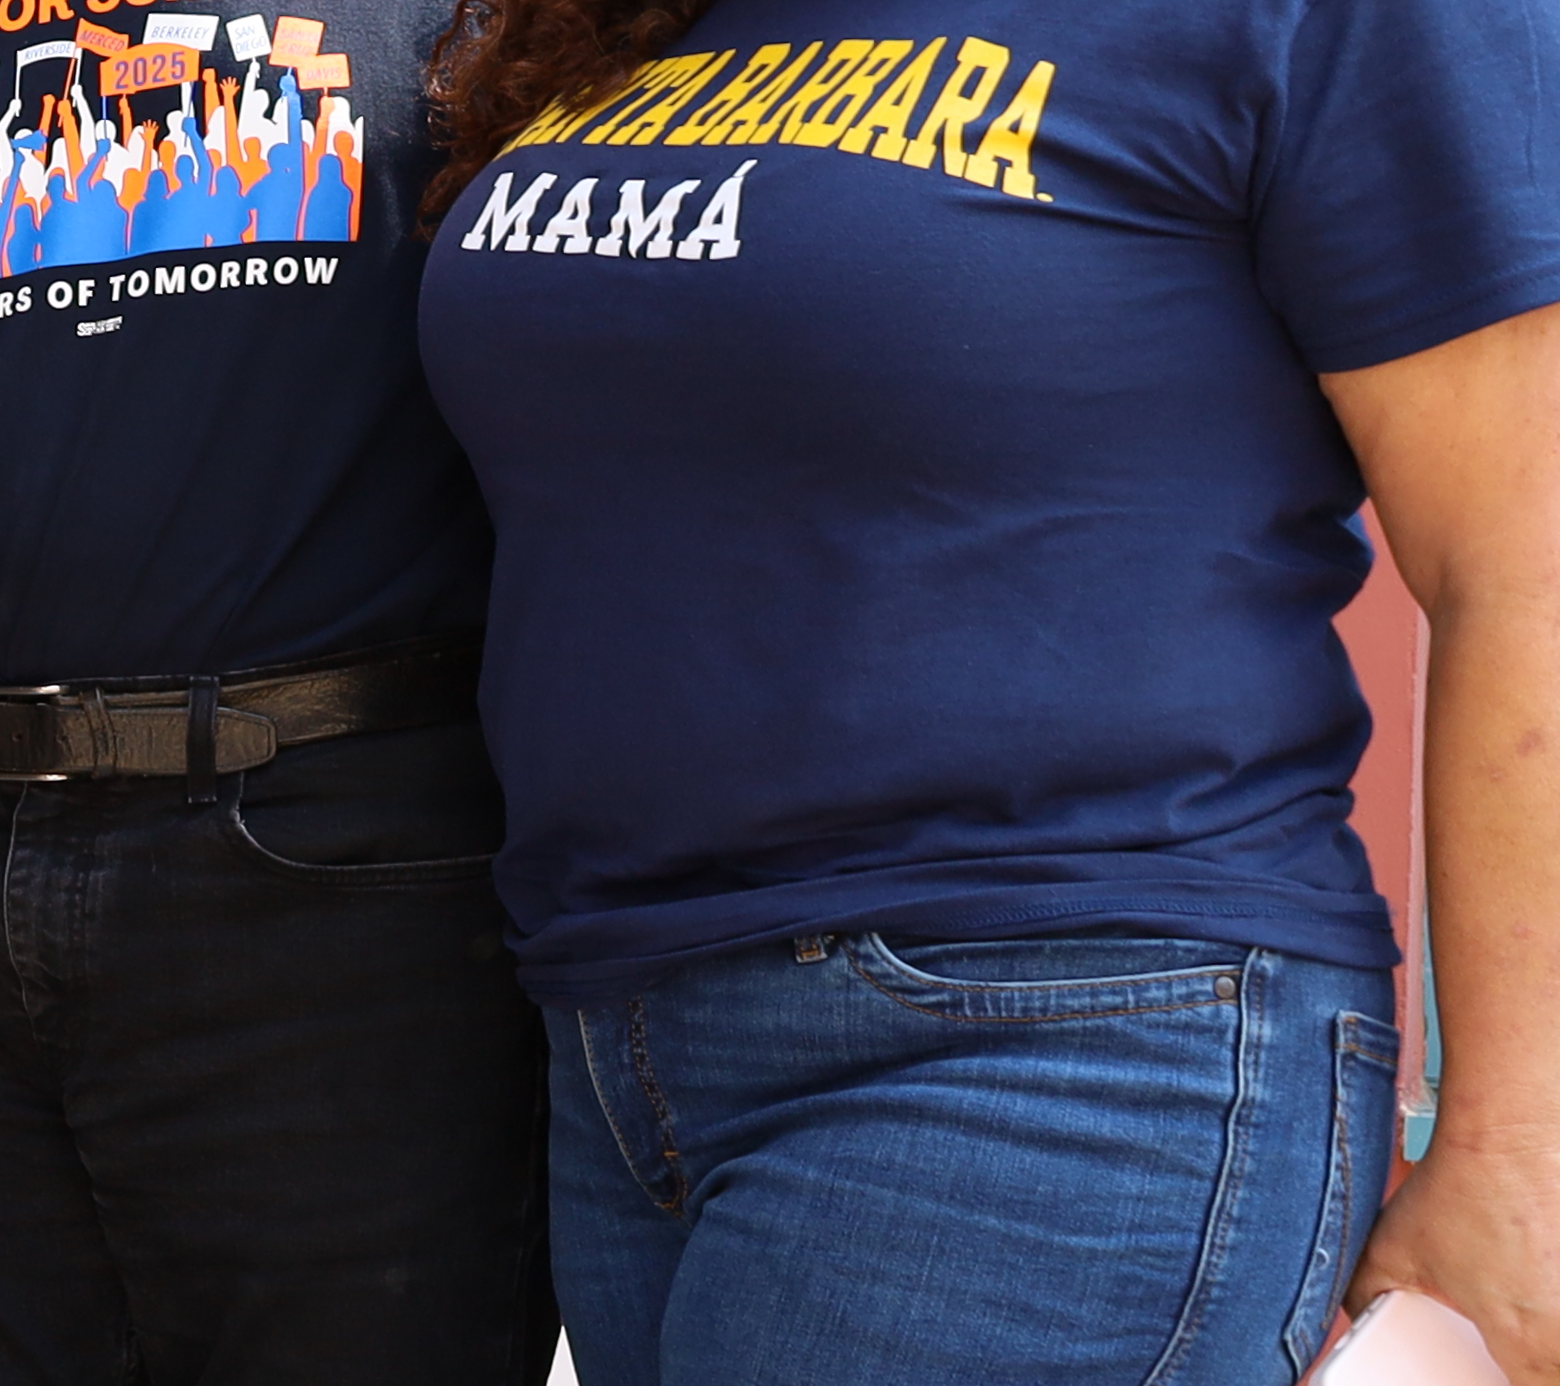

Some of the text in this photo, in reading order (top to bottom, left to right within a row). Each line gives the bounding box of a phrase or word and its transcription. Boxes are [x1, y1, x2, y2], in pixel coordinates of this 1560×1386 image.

[81, 29, 125, 53] MERCED
[151, 25, 210, 40] BERKELEY
[235, 24, 256, 40] SAN
[24, 43, 72, 61] RIVERSIDE
[235, 36, 267, 55] DIEGO
[115, 51, 186, 90] 2025
[492, 48, 737, 162] ANTA
[460, 160, 758, 261] MAMÁ
[47, 278, 95, 309] OF
[108, 257, 340, 303] TOMORROW
